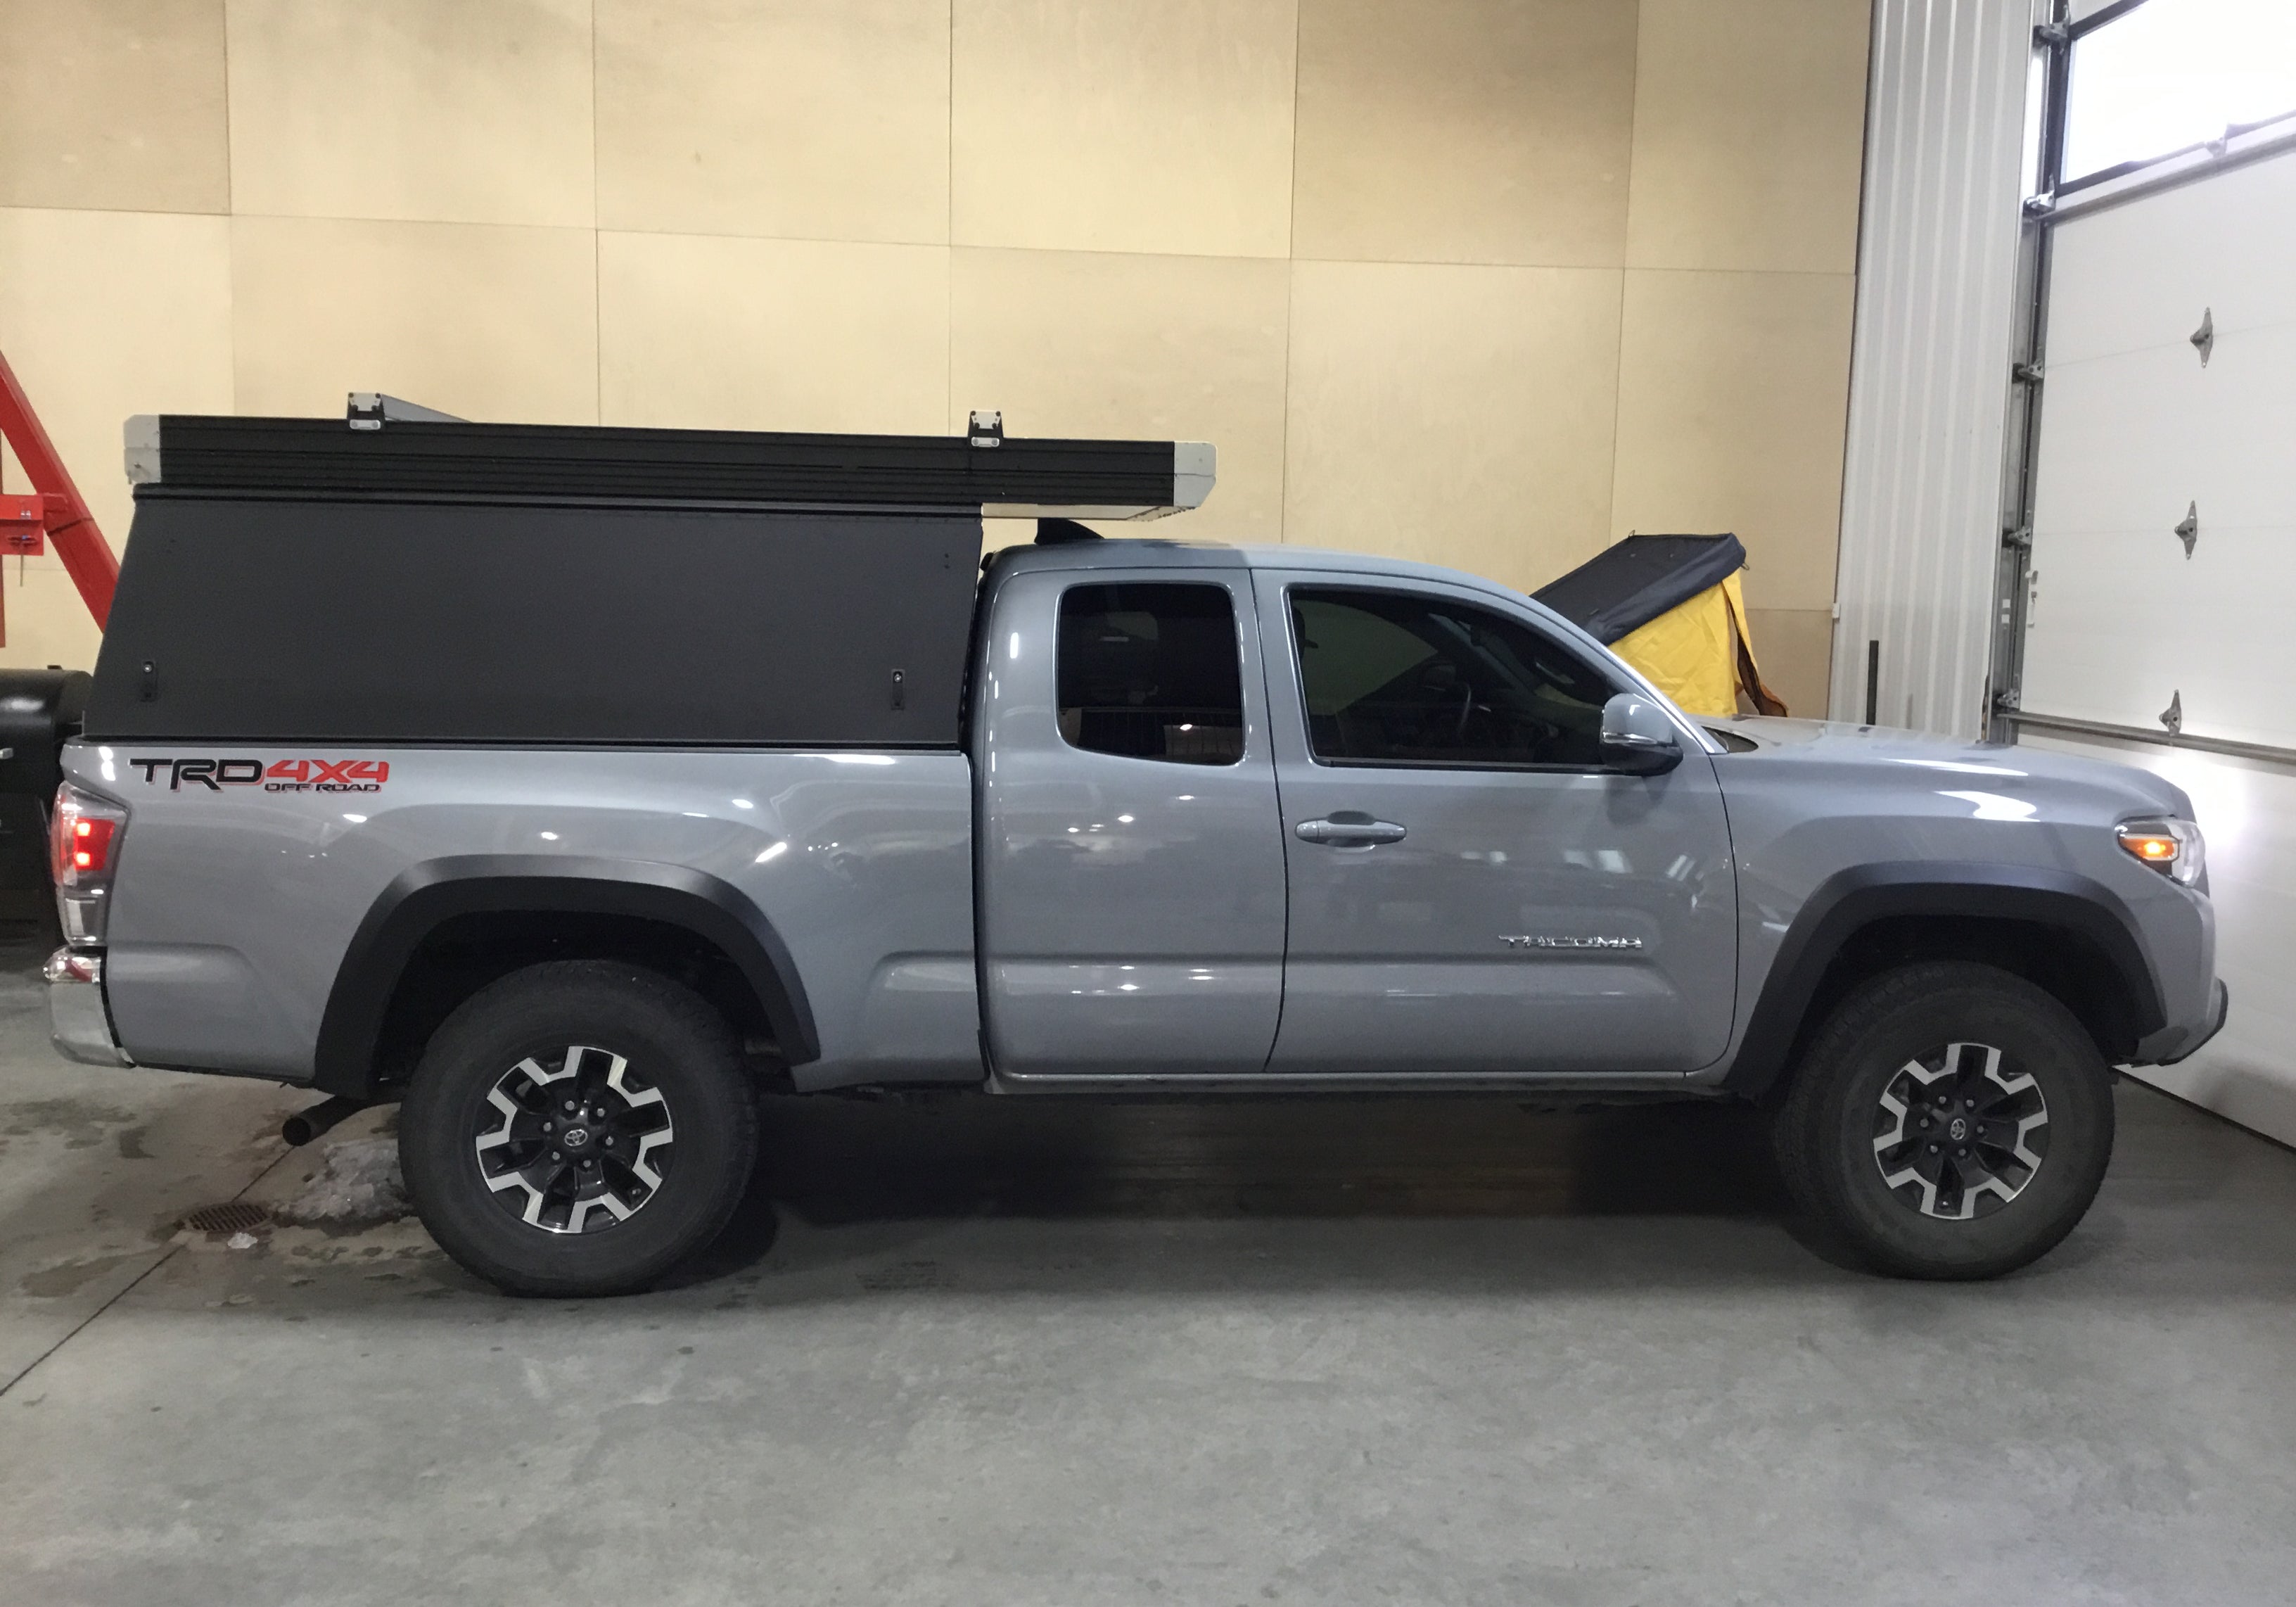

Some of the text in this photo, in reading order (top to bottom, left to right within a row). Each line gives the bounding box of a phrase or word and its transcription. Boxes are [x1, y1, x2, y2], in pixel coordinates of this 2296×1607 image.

[129, 758, 390, 792] TRD 4X4
[264, 783, 381, 793] OFF ROAD
[1498, 935, 1643, 949] TACOMA
